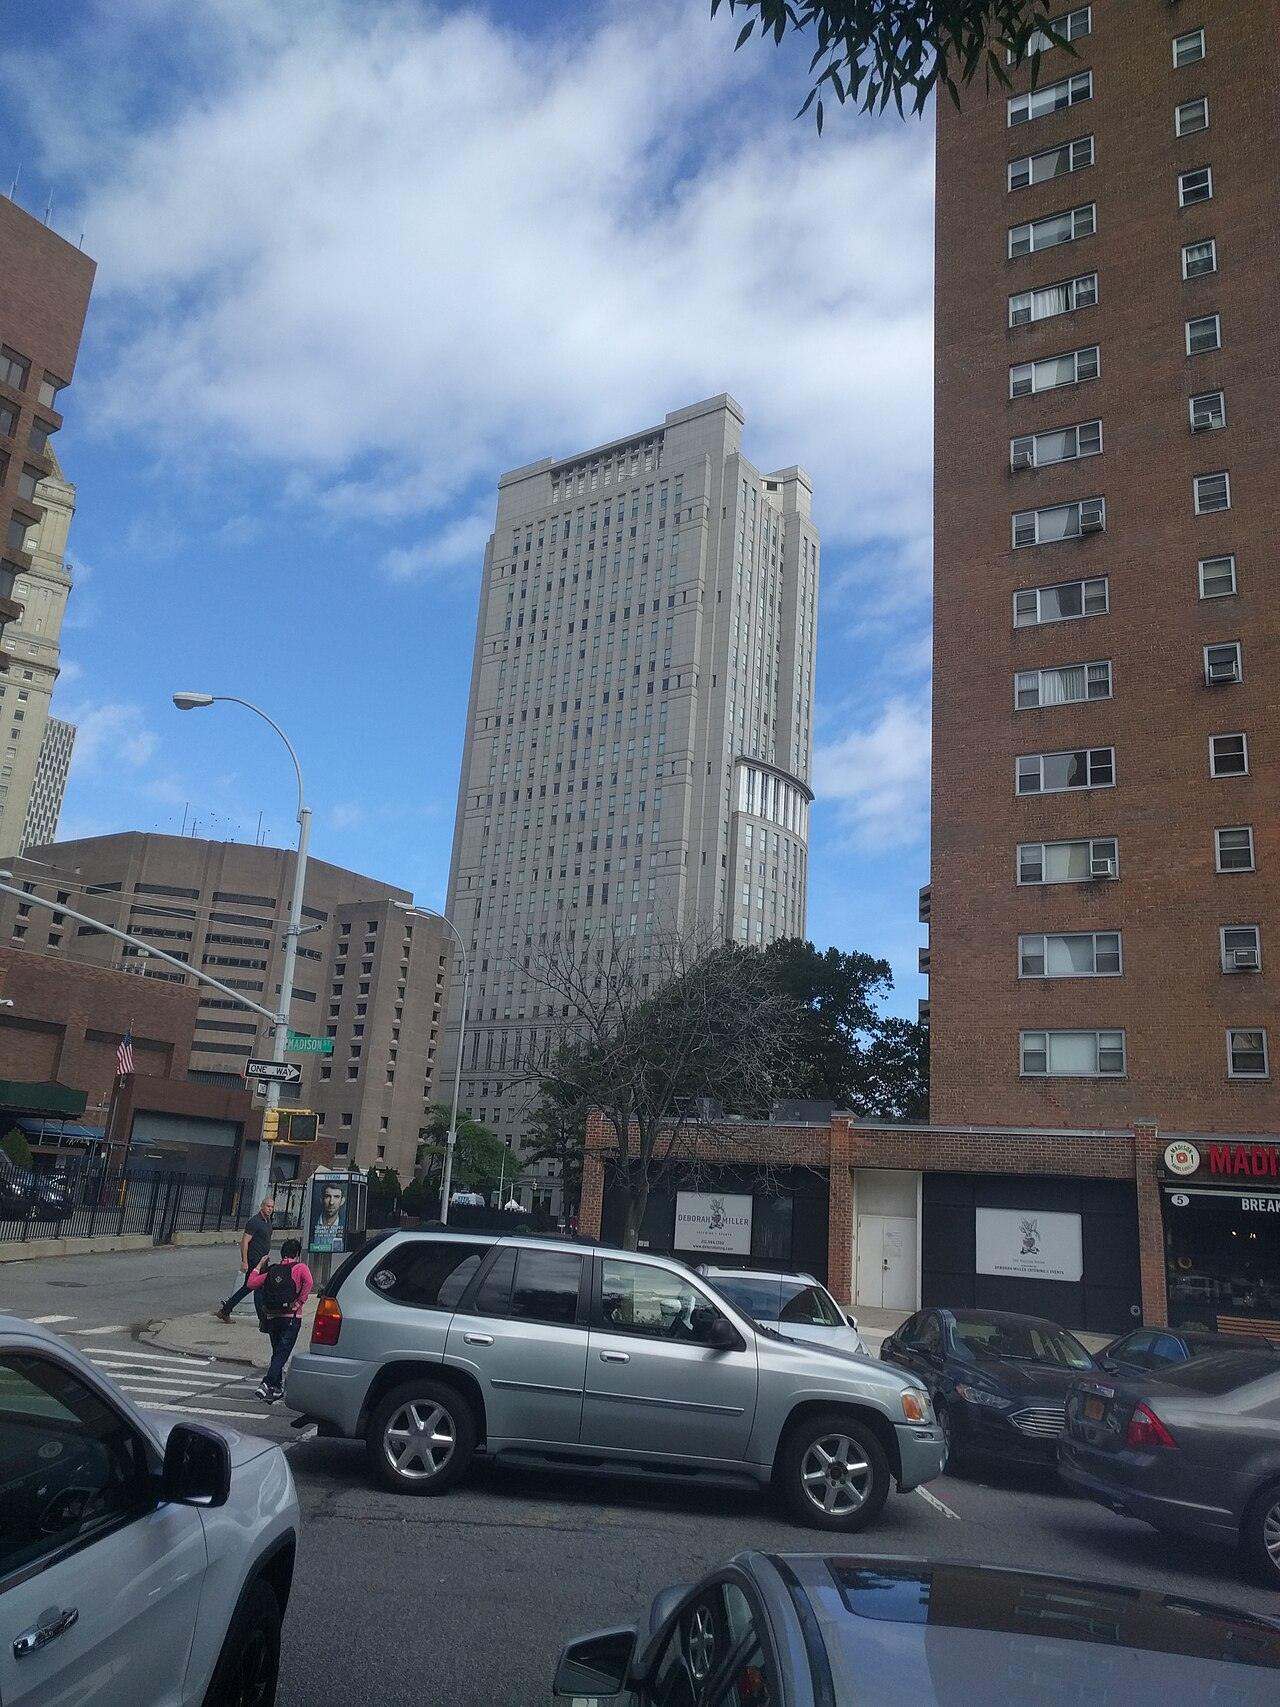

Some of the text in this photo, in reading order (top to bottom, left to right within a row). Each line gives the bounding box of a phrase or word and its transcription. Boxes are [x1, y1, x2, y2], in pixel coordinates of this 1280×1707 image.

[288, 1039, 322, 1050] MADISON
[250, 1064, 294, 1076] ONE WAY
[1209, 1143, 1280, 1176] MADI
[1176, 1195, 1184, 1205] 5
[678, 1214, 749, 1226] DEBORAH MILLER
